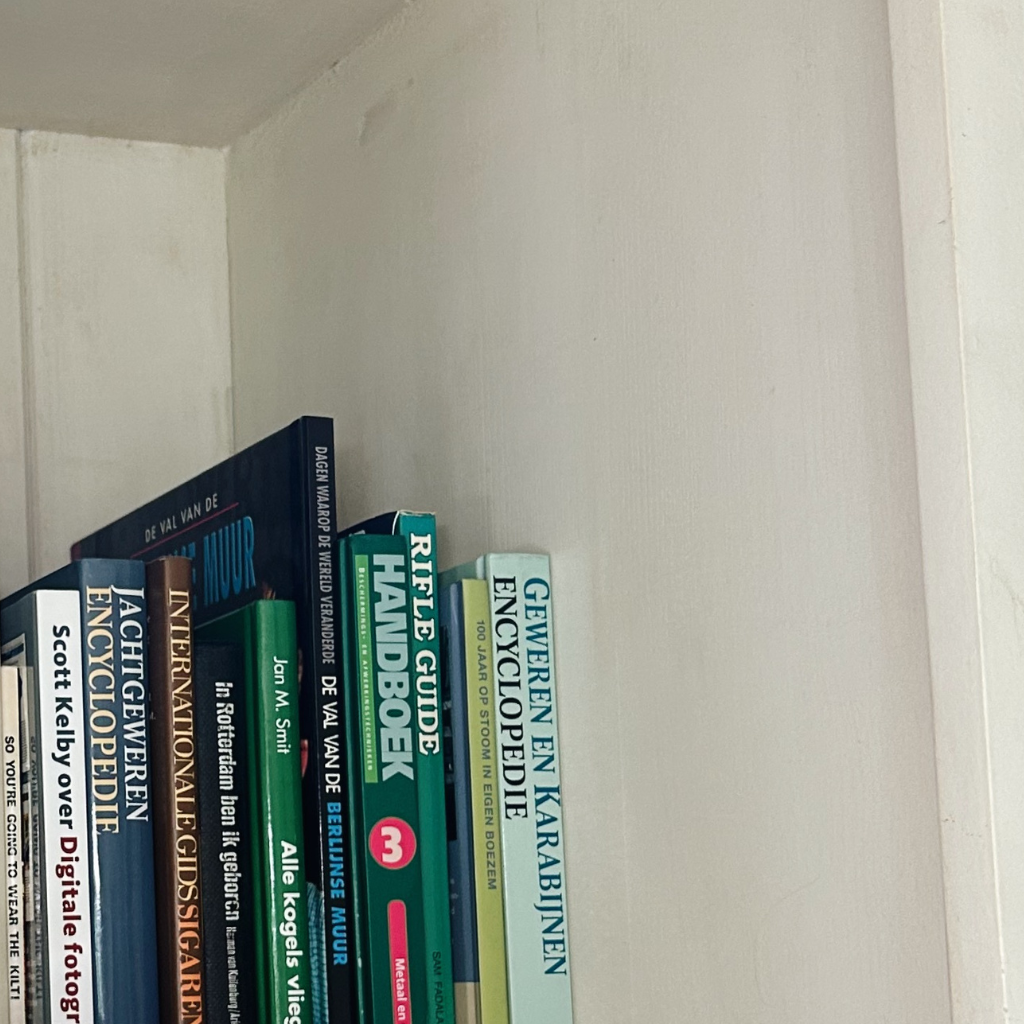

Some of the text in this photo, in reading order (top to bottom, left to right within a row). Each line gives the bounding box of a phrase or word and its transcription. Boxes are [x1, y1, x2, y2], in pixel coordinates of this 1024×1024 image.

[144, 493, 219, 544] DE VAL VAN DE
[203, 515, 256, 609] MUUR
[52, 625, 71, 690] Scott
[373, 554, 415, 782] HANDBOEK
[410, 533, 441, 756] RIFLE GUIDE
[51, 696, 75, 767] Kelby
[86, 585, 120, 836] ENCYCLOPEDIE
[110, 584, 148, 822] JACHTGEWEREN
[168, 587, 197, 831] INTERNATIONALE
[273, 656, 291, 754] Jan M. Smit
[315, 446, 348, 966] DAGEN WAAROP DE WERELD VERANDERDE DE VAL VAN DE BERLIJNSE MUUR
[493, 575, 528, 821] ENCYCLOPEDIE
[216, 702, 237, 791] Rotterdam
[476, 619, 497, 890] 100 JAAR OP STOOM IN EIGEN BOEZEM
[523, 577, 567, 976] GEWEREN EN KARABIJNEN
[57, 773, 74, 830] over
[220, 795, 239, 827] ben
[222, 831, 240, 848] ik
[4, 736, 21, 1000] SO YOU'RE GOING TO WEAR THE KILT!
[176, 834, 199, 901] GIDS
[280, 840, 299, 885] Alle
[380, 825, 403, 863] 3
[55, 837, 82, 937] Digitale
[219, 851, 242, 922] geboren
[279, 892, 303, 968] kogels
[394, 957, 408, 1002] Metaal
[397, 1004, 406, 1021] en
[432, 951, 444, 1024] SAM FADALA
